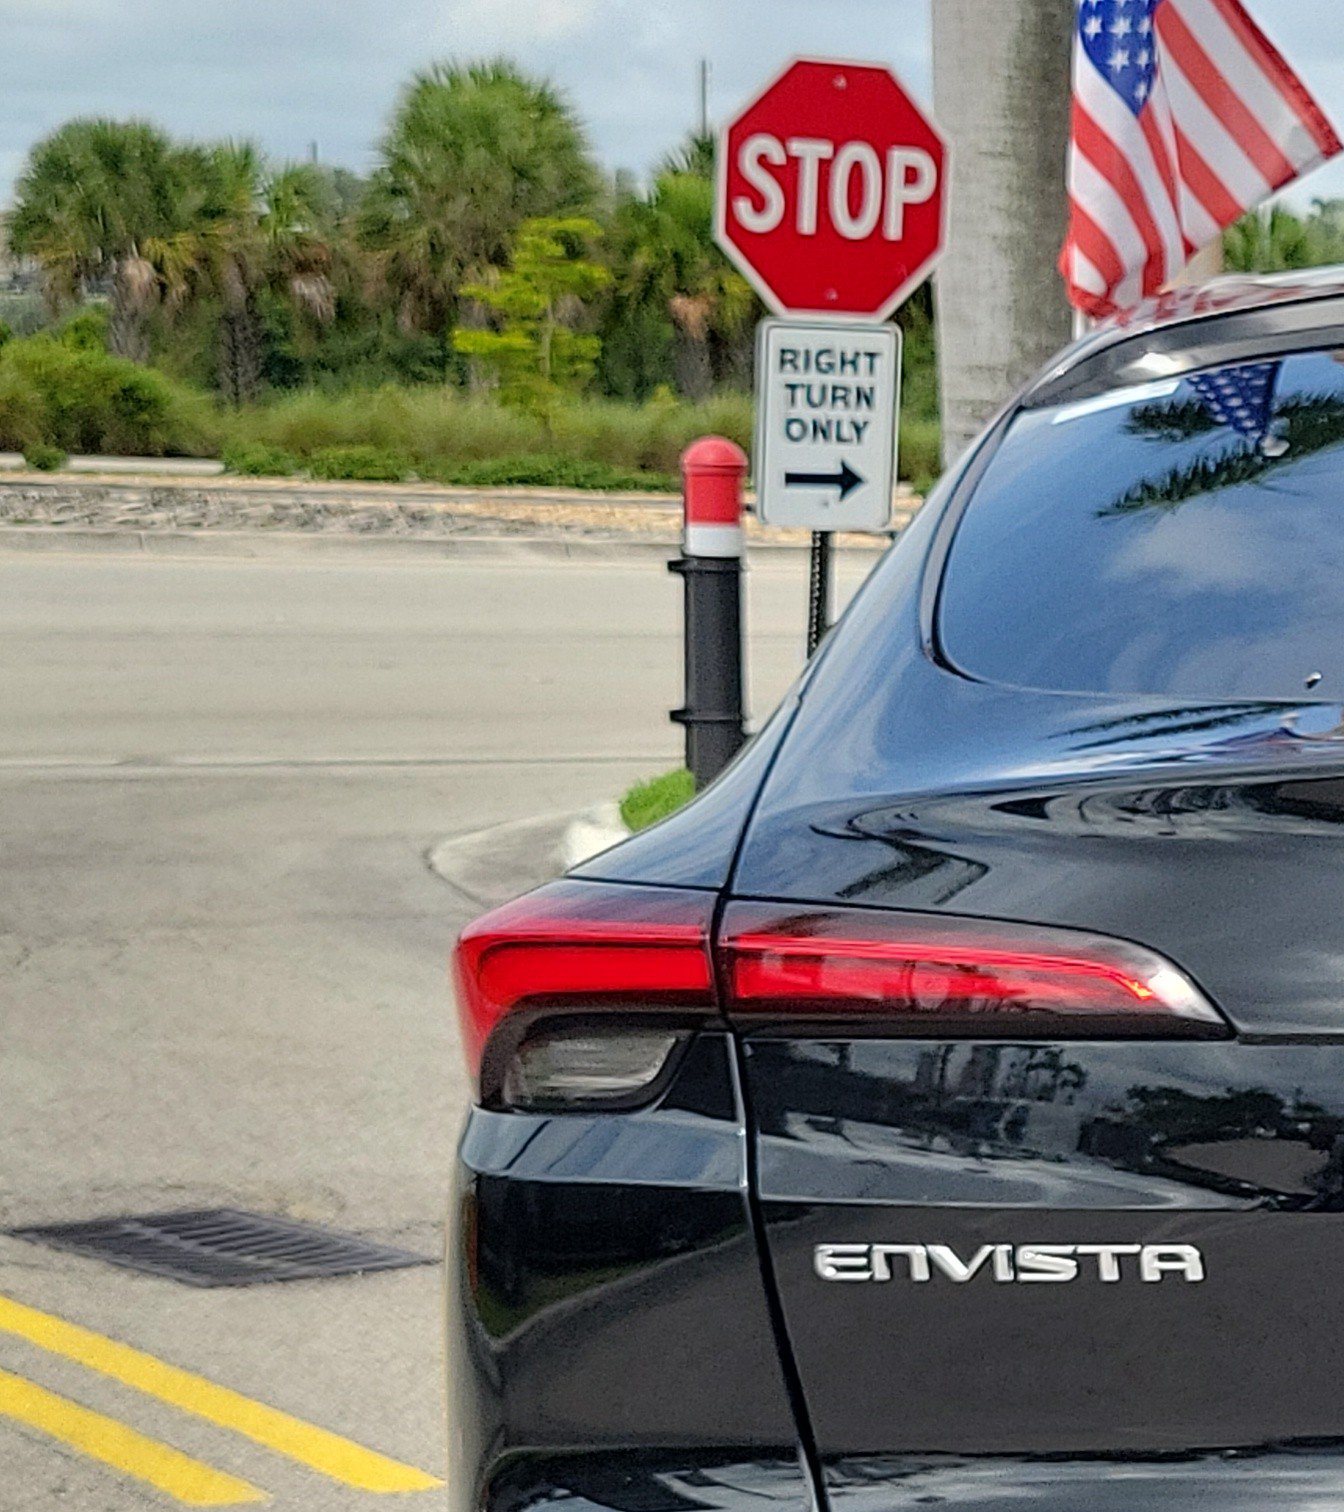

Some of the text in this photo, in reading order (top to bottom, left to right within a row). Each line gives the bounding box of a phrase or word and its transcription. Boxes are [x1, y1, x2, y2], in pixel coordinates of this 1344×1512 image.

[731, 132, 938, 241] STOP
[779, 348, 882, 375] RIGHT
[784, 382, 875, 410] TURN
[784, 417, 870, 444] ONLY
[814, 1243, 1206, 1284] ENVISTA
